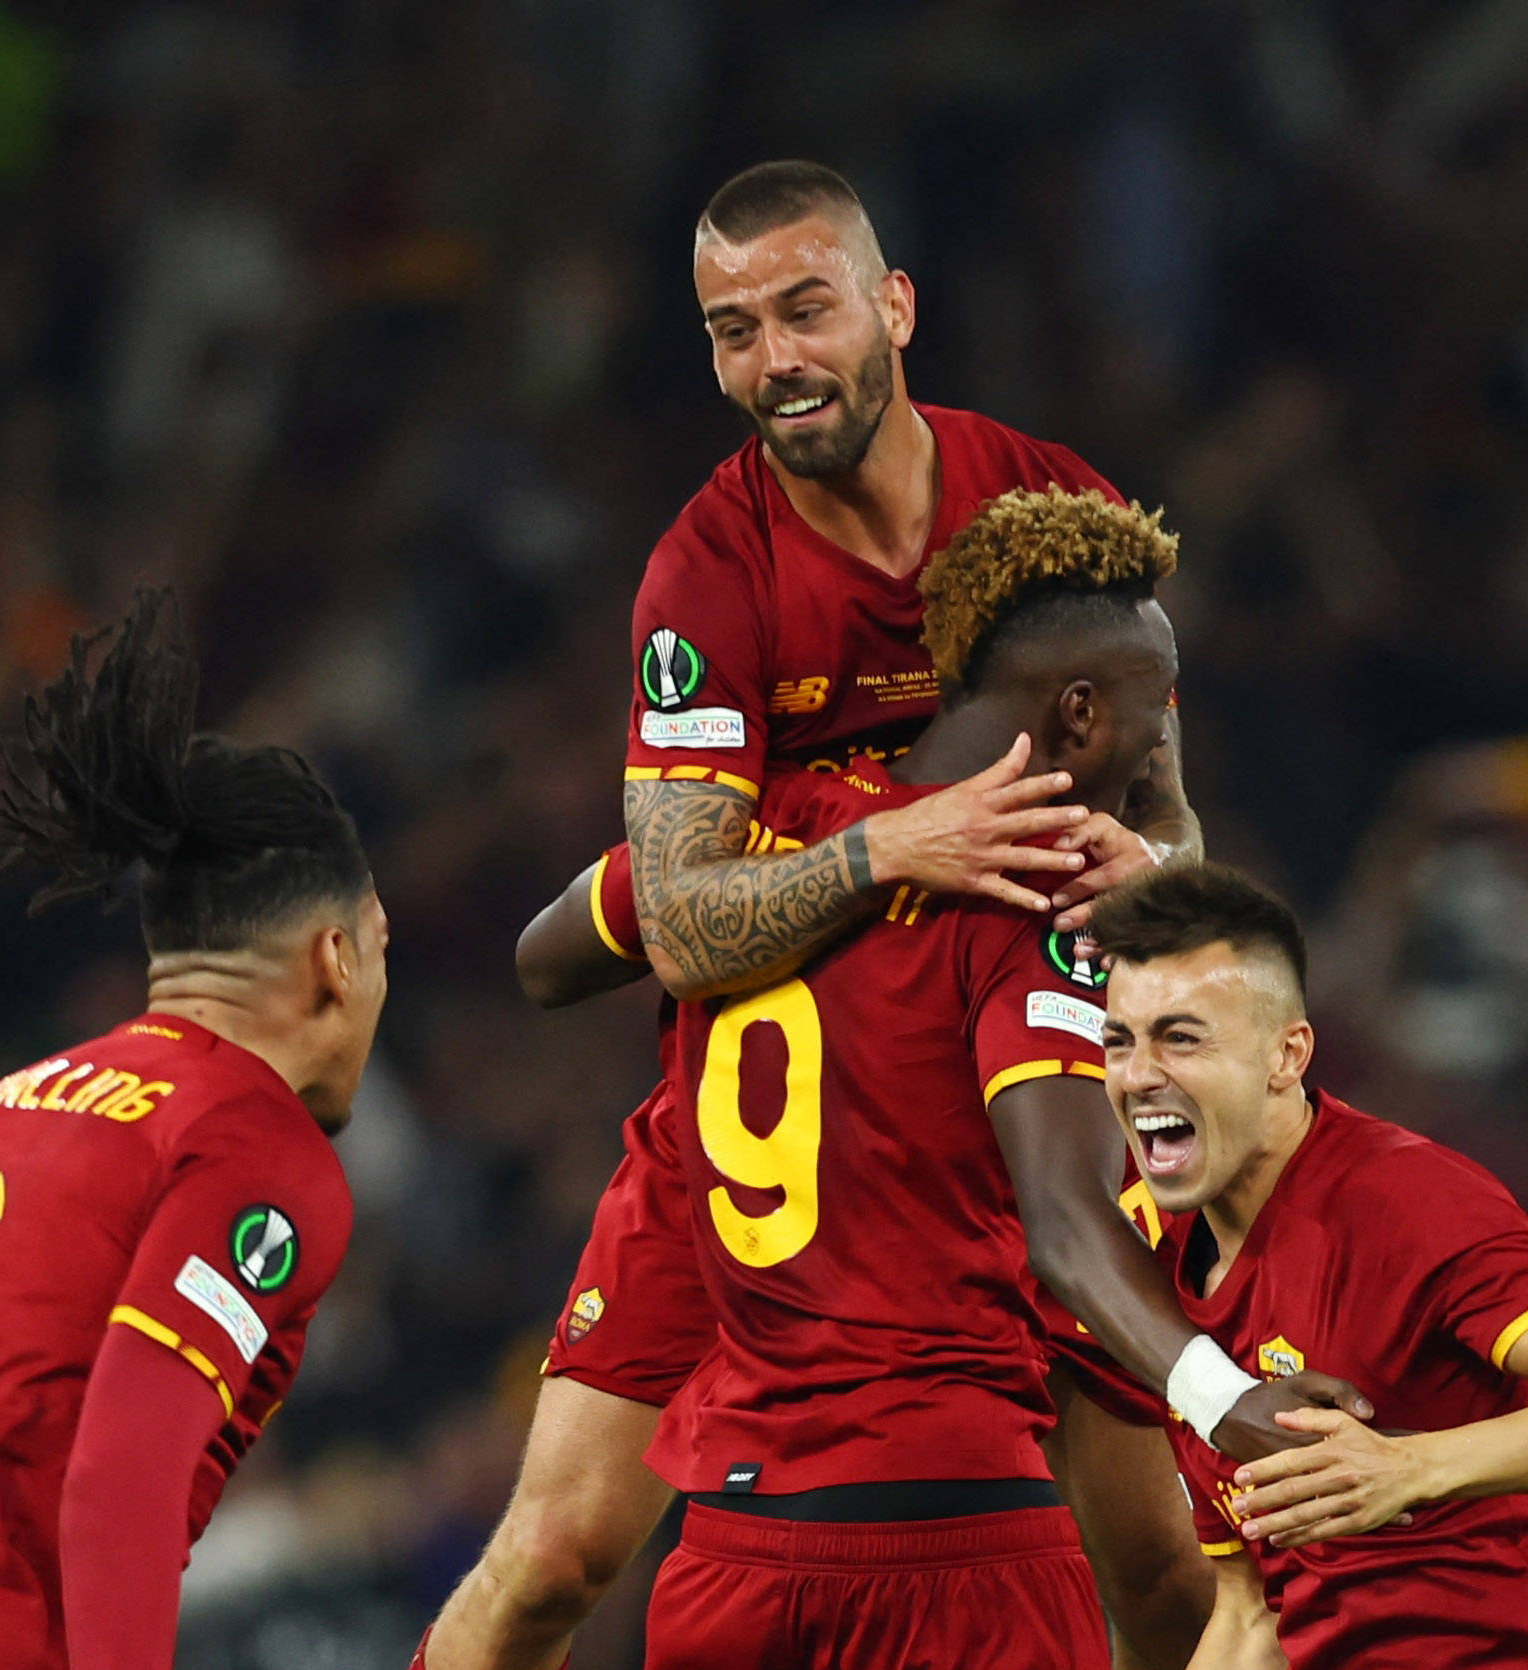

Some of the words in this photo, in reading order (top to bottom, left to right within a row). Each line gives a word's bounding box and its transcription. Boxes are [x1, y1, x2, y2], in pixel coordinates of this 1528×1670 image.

[856, 675, 889, 687] FINAL
[891, 670, 930, 684] TIRANA
[644, 720, 741, 737] FOUNDATION
[1031, 1002, 1102, 1032] FOUNDAT
[697, 977, 822, 1268] 9
